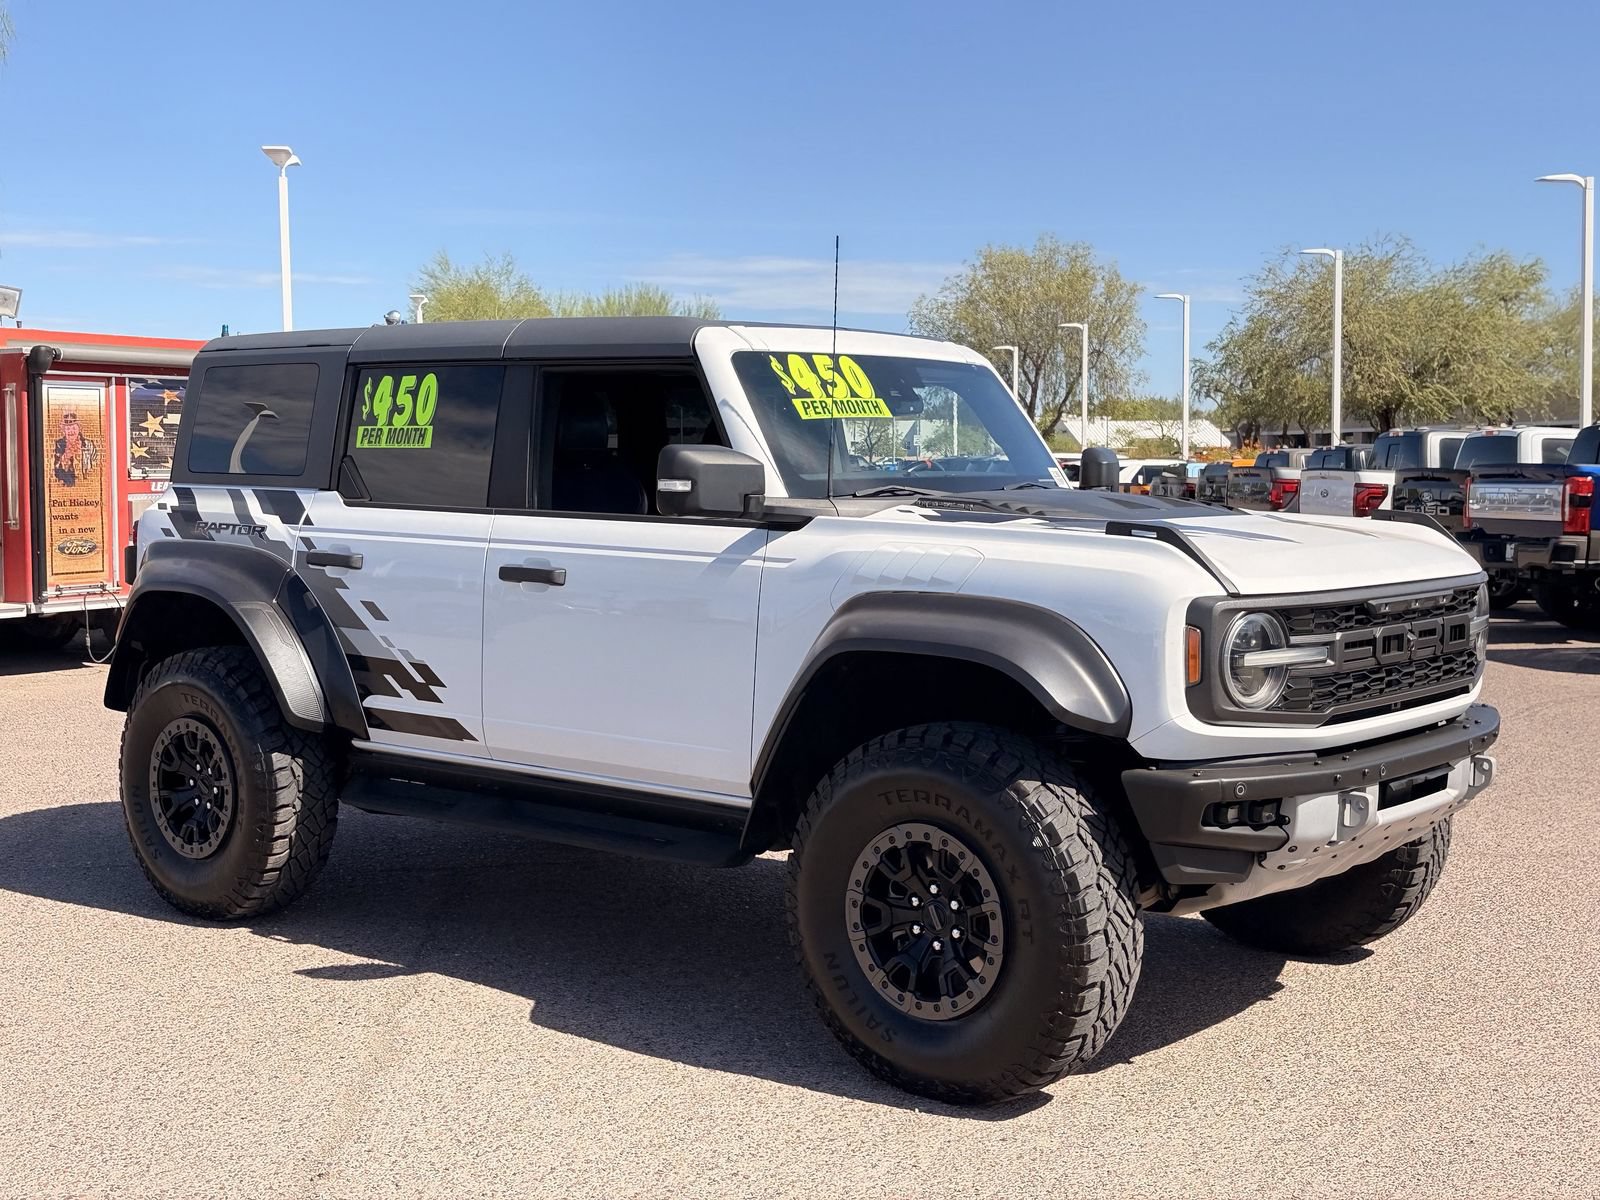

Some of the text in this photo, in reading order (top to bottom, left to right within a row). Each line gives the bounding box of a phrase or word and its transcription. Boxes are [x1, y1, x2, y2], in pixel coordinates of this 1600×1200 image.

[769, 354, 875, 399] $450
[362, 373, 439, 427] $450
[801, 400, 882, 416] PER MONTH
[360, 428, 428, 446] PER MONTH
[52, 498, 100, 509] Pat Hickey
[58, 526, 68, 534] in
[194, 521, 267, 544] RAPTOR
[63, 540, 95, 554] Ford
[1335, 614, 1470, 673] FORD
[877, 788, 1022, 885] TERRAMAX
[823, 952, 898, 1043] SAILUN
